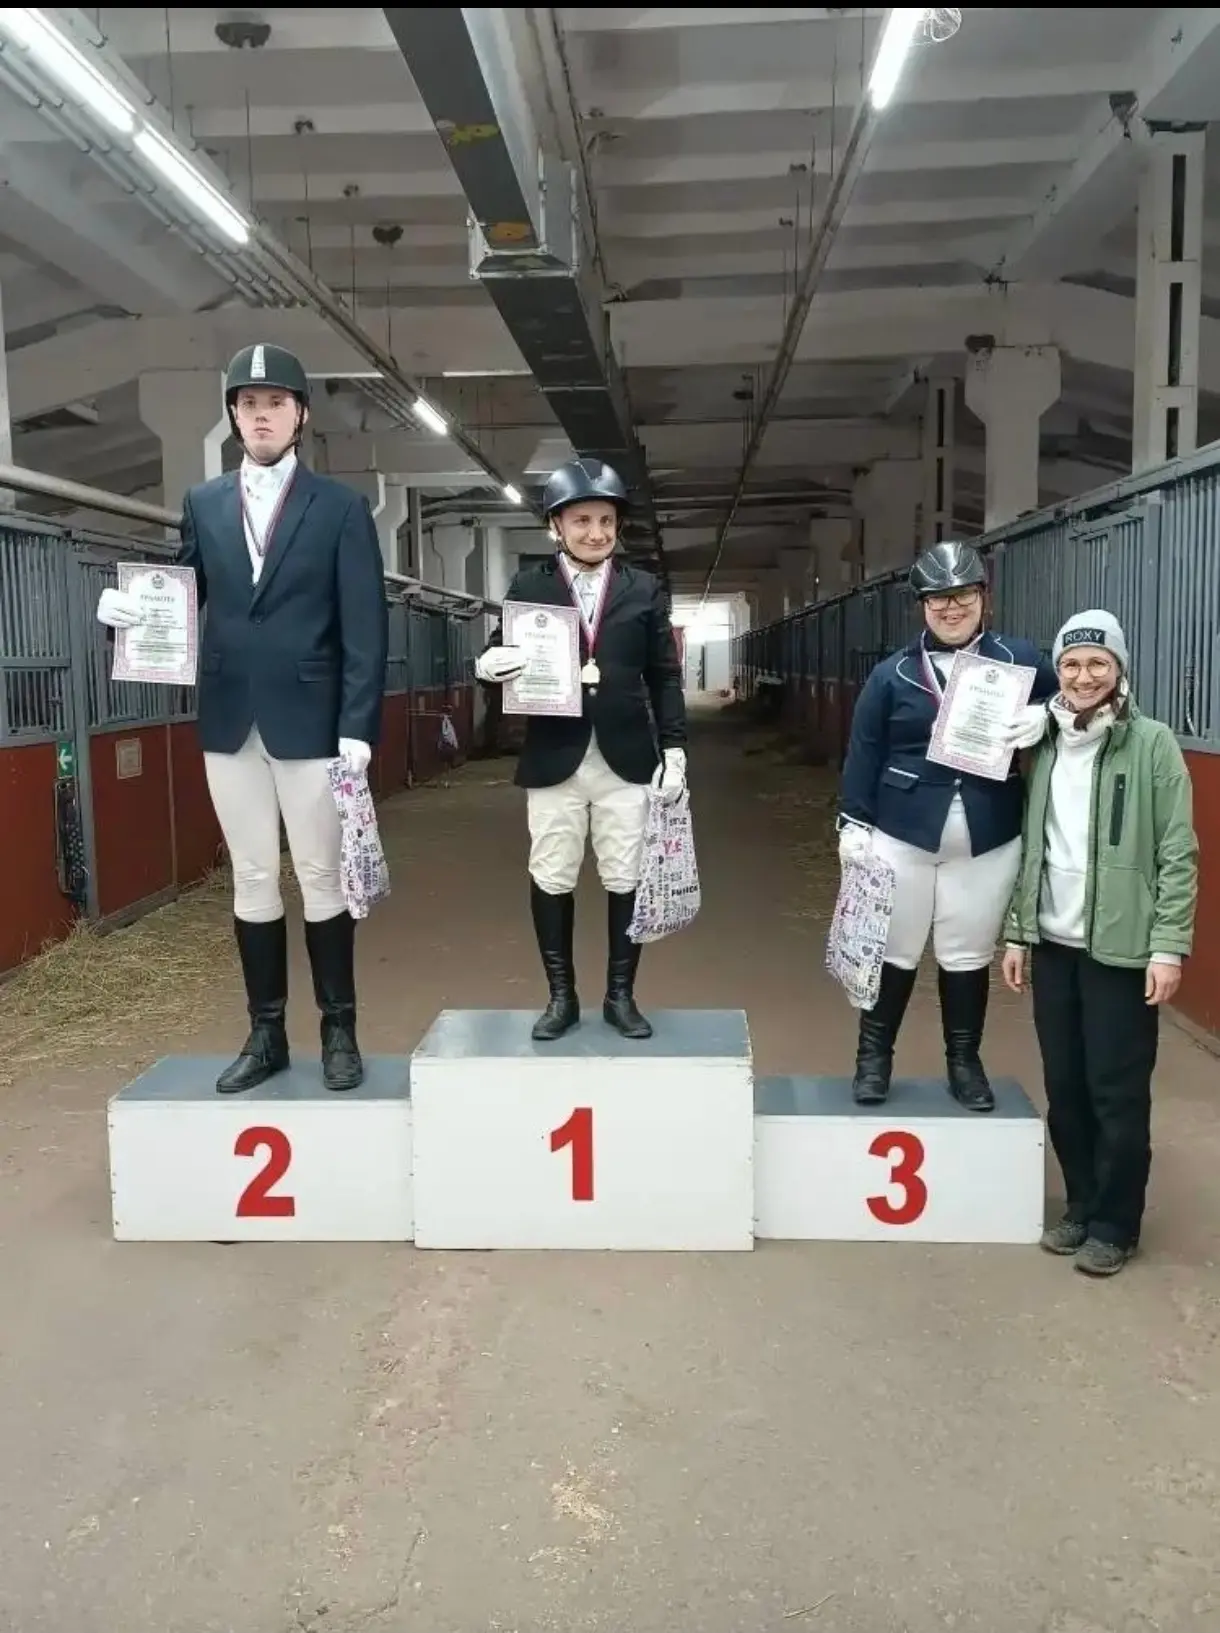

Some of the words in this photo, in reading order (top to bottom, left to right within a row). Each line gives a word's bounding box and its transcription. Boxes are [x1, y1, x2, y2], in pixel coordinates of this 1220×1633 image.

[1065, 629, 1102, 644] ROXY
[234, 1126, 295, 1218] 2
[550, 1108, 594, 1201] 1
[867, 1131, 928, 1225] 3
